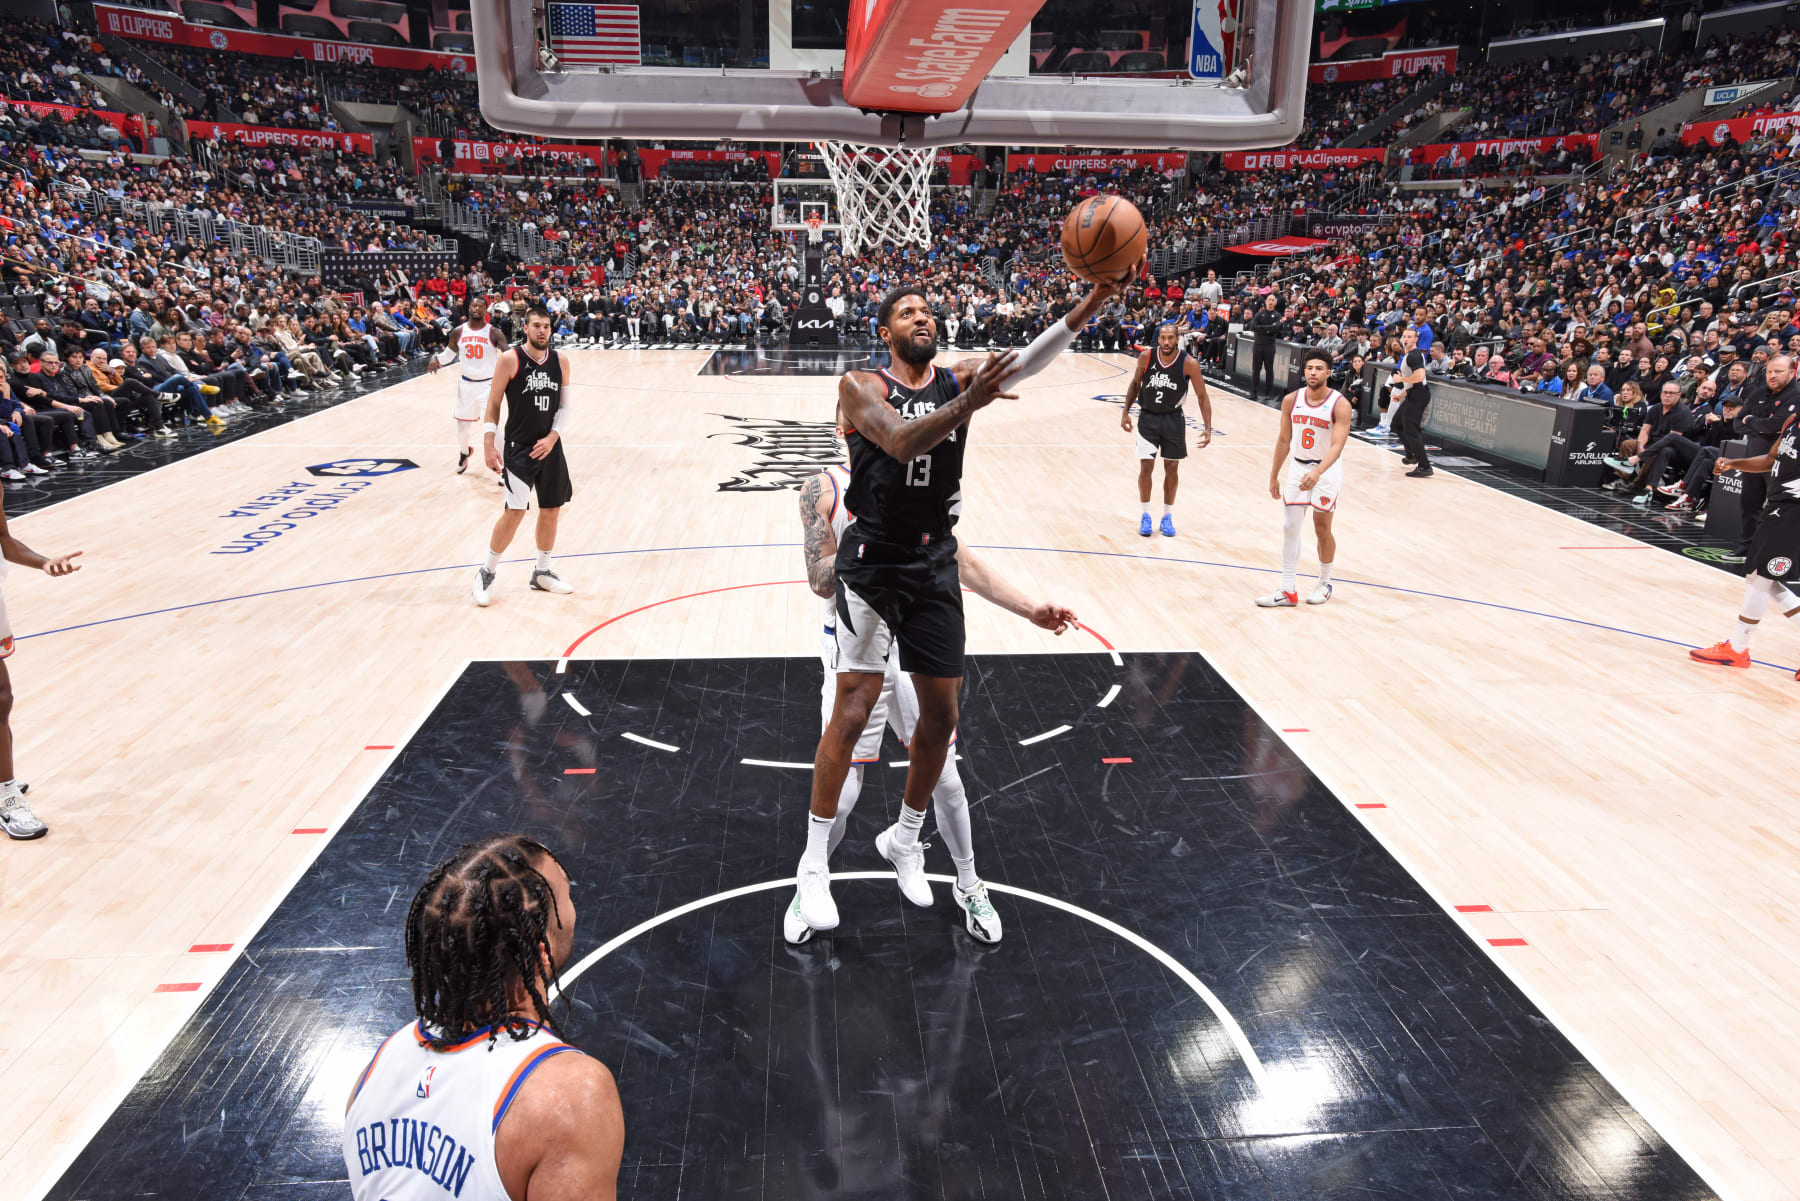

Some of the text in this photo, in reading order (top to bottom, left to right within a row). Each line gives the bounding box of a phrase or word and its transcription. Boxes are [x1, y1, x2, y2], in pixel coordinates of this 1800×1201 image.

[107, 12, 173, 39] LA CLIPPERS
[313, 42, 325, 62] LA
[1195, 54, 1217, 72] NBA
[1716, 91, 1735, 99] UCLA
[1754, 115, 1800, 137] CLIPPER
[235, 130, 334, 148] CLIPPERSCOM
[1055, 158, 1137, 169] CLIPPERSCOM
[1325, 223, 1377, 239] cryptoco
[465, 344, 484, 359] 30
[531, 370, 548, 380] Los
[522, 375, 559, 394] Angeles
[534, 396, 550, 411] 40
[1155, 391, 1164, 404] 2
[1434, 399, 1485, 420] DEPARTMENT
[1486, 411, 1499, 424] OF
[1292, 415, 1330, 430] NEW YORK
[1433, 409, 1462, 426] MENTAL
[1464, 417, 1497, 436] HEALTH
[1301, 428, 1315, 450] 6
[1568, 452, 1610, 460] STARLUX
[905, 454, 932, 487] 13
[1718, 475, 1742, 488] STARL
[1722, 485, 1743, 494] AIRLIN
[218, 481, 317, 518] ARENA
[210, 481, 373, 554] crypto.com
[356, 1118, 475, 1199] BRUNSON
